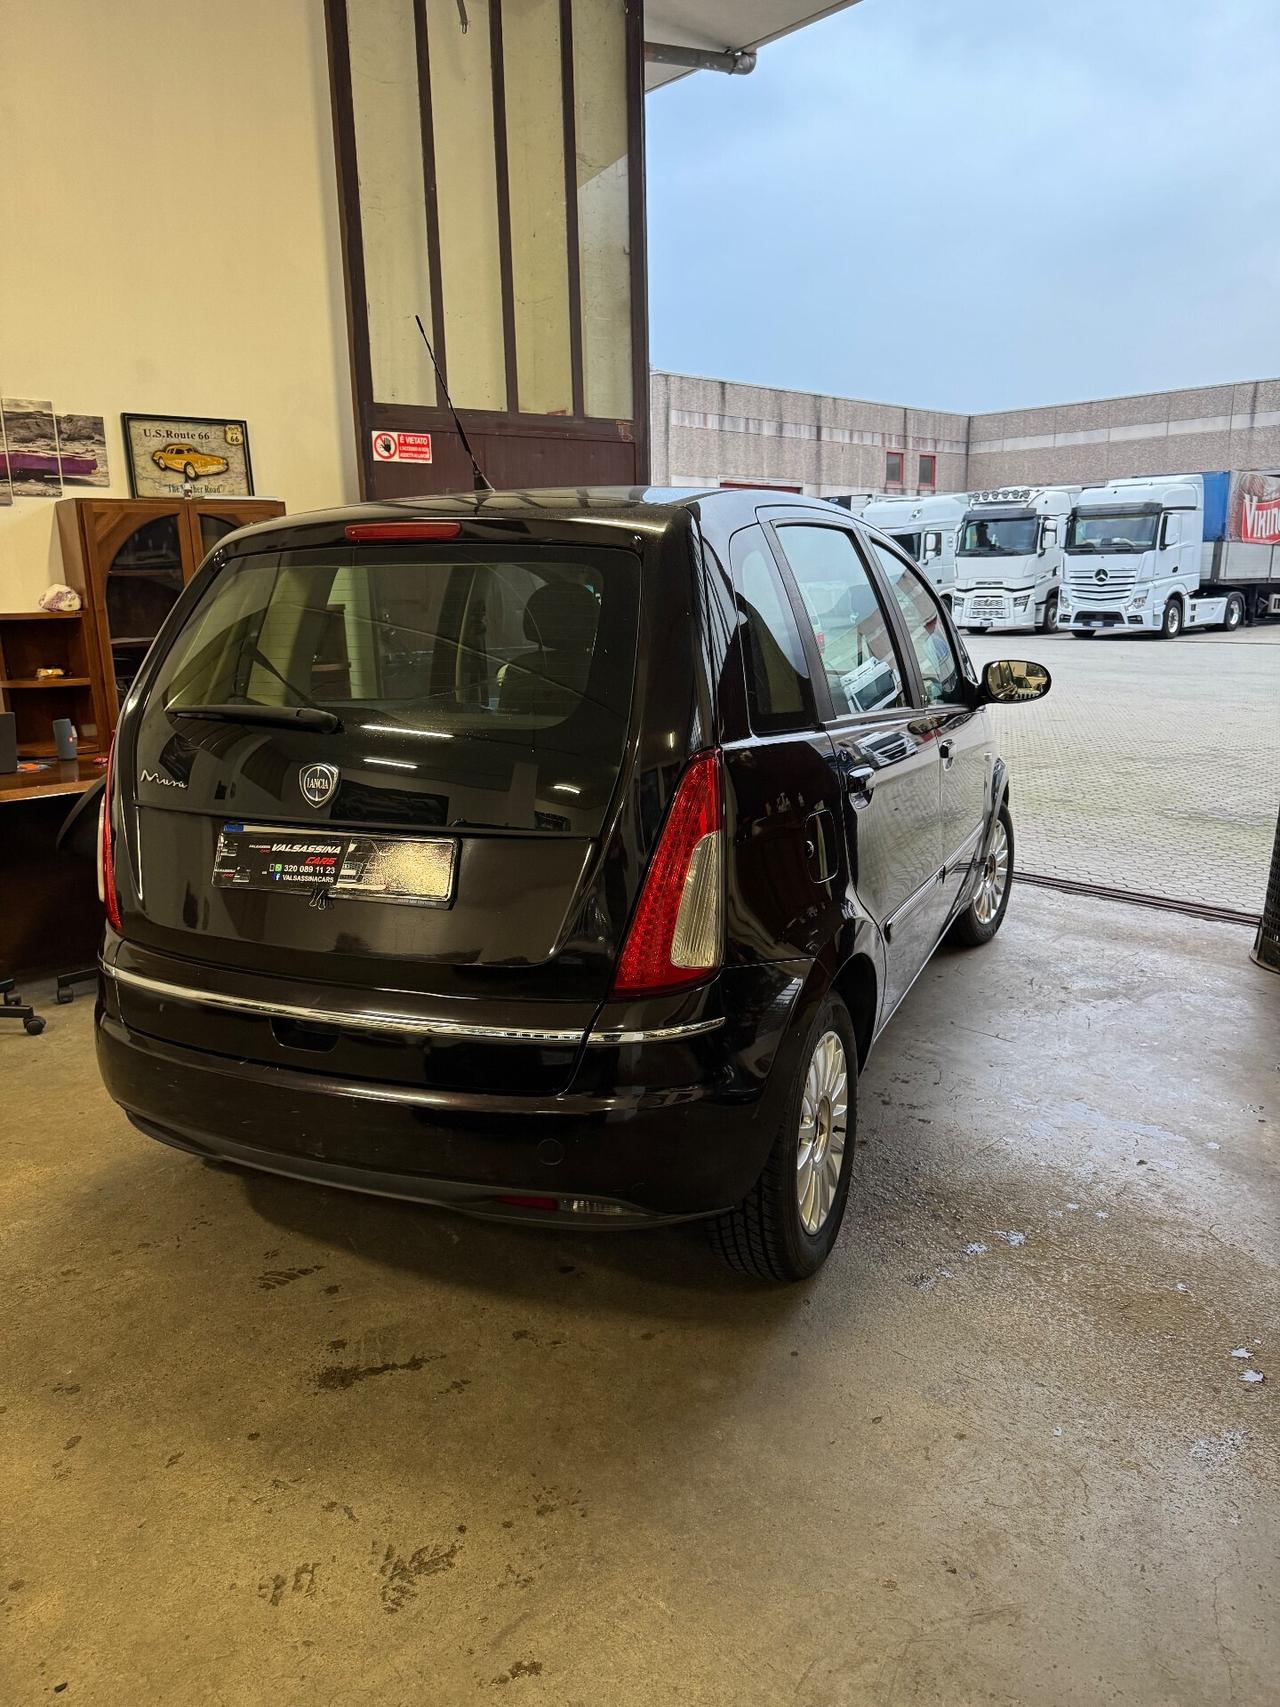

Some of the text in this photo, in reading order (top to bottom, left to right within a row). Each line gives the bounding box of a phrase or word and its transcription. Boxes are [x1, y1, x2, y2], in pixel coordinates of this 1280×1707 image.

[198, 431, 210, 440] 66
[230, 435, 240, 443] 66
[405, 436, 428, 445] VIETATO
[306, 777, 329, 790] LANCIA
[271, 843, 342, 854] VALSASSINA
[305, 856, 337, 865] CARS
[283, 864, 336, 874] 320 089 11 23
[282, 874, 335, 883] VALSASSINACARS
